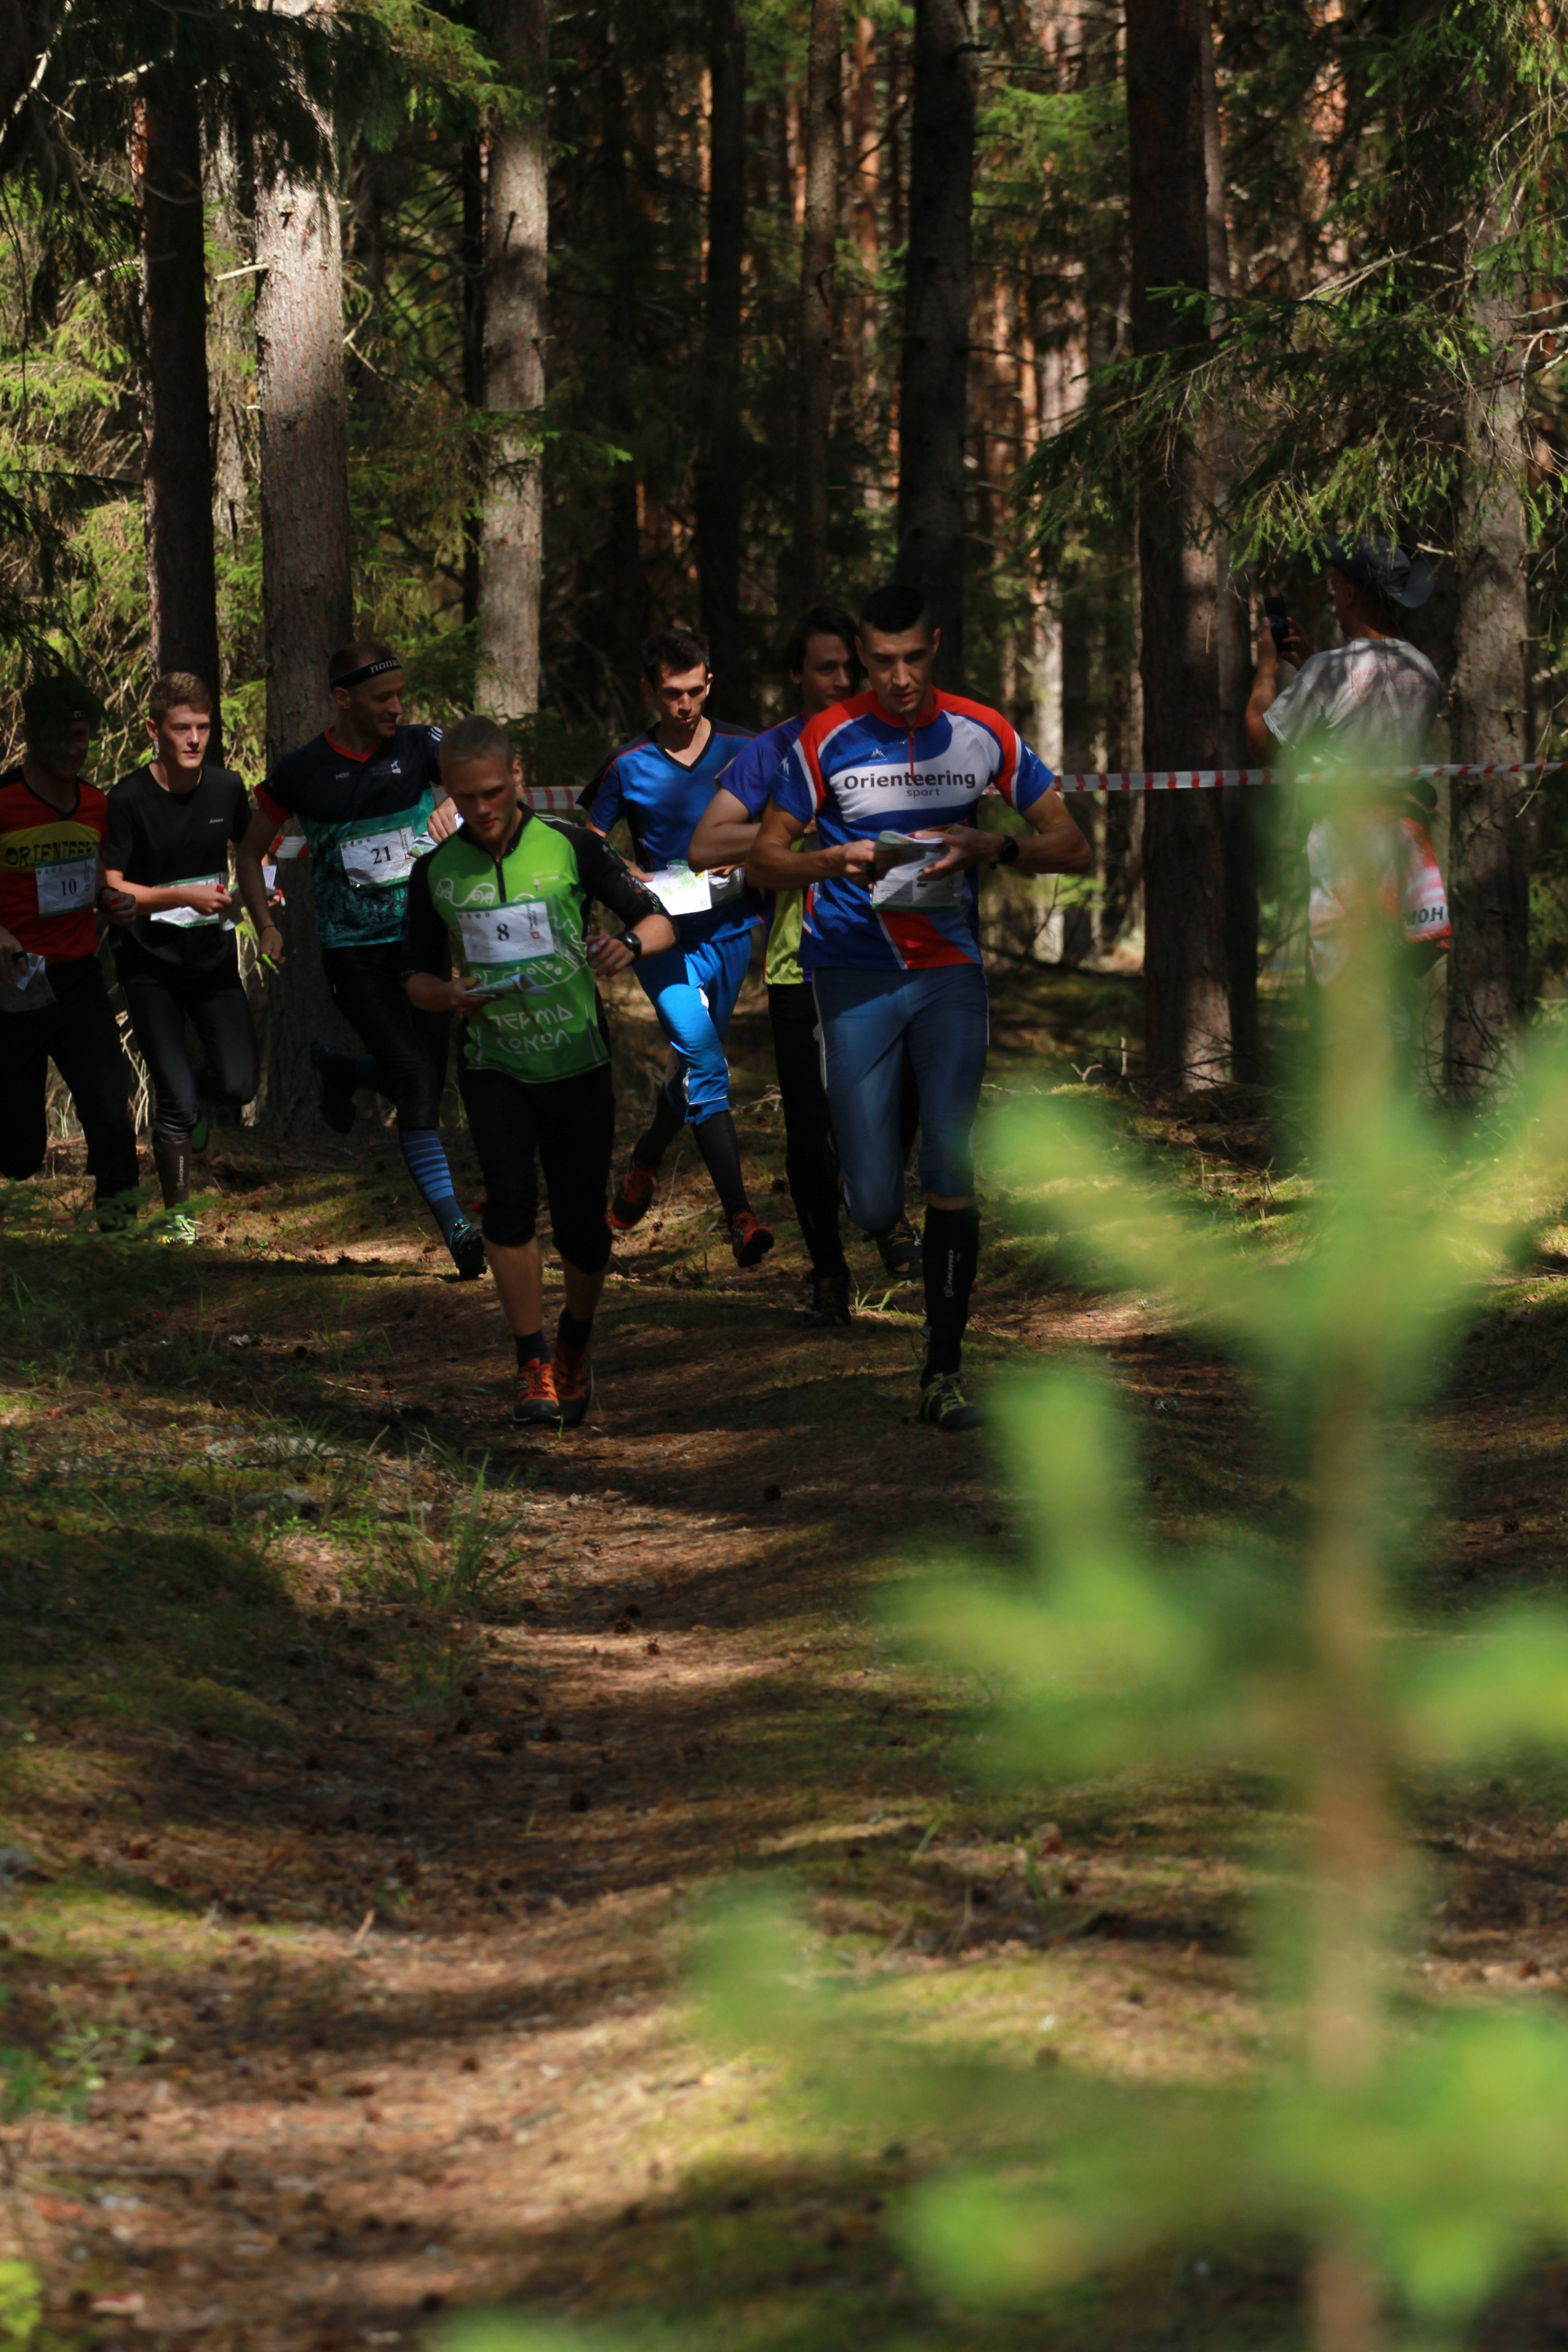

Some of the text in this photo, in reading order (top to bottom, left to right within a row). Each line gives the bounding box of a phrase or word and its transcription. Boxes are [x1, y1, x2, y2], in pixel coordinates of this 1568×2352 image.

[844, 771, 976, 790] Orienteering
[907, 788, 941, 799] sport
[371, 845, 391, 865] 21
[61, 878, 77, 896] 10
[497, 924, 510, 941] 8
